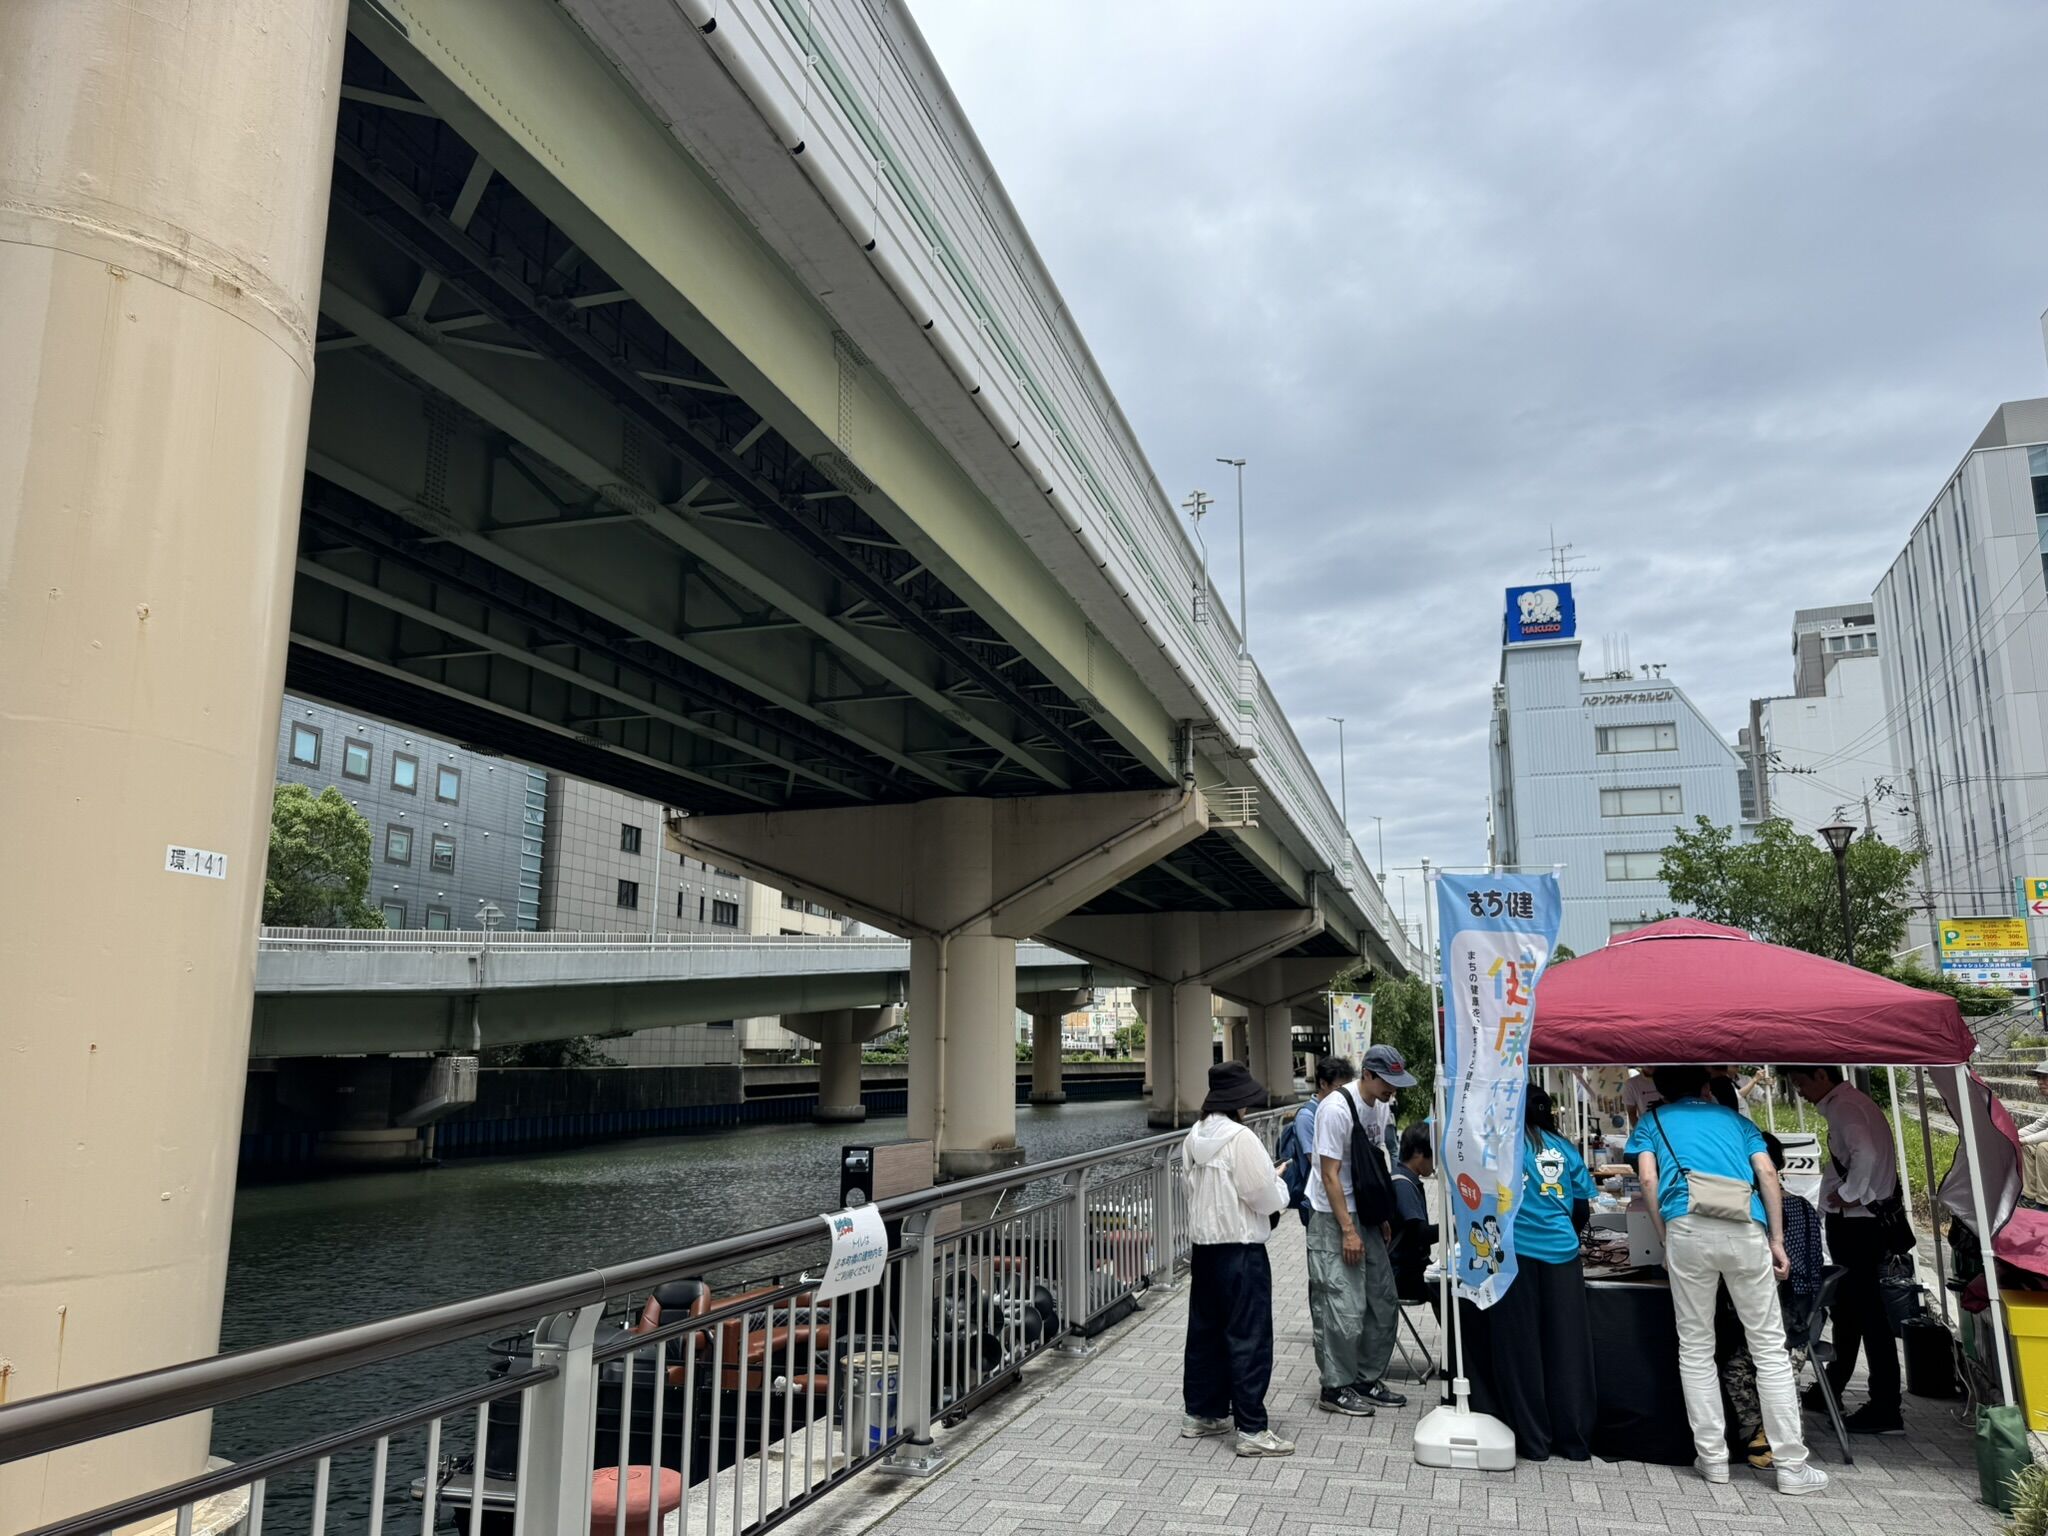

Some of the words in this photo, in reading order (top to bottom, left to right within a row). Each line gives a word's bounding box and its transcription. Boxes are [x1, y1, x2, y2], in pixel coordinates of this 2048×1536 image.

[1521, 623, 1561, 634] HAKUZO
[1467, 889, 1534, 919] まち健
[1944, 930, 1960, 945] P
